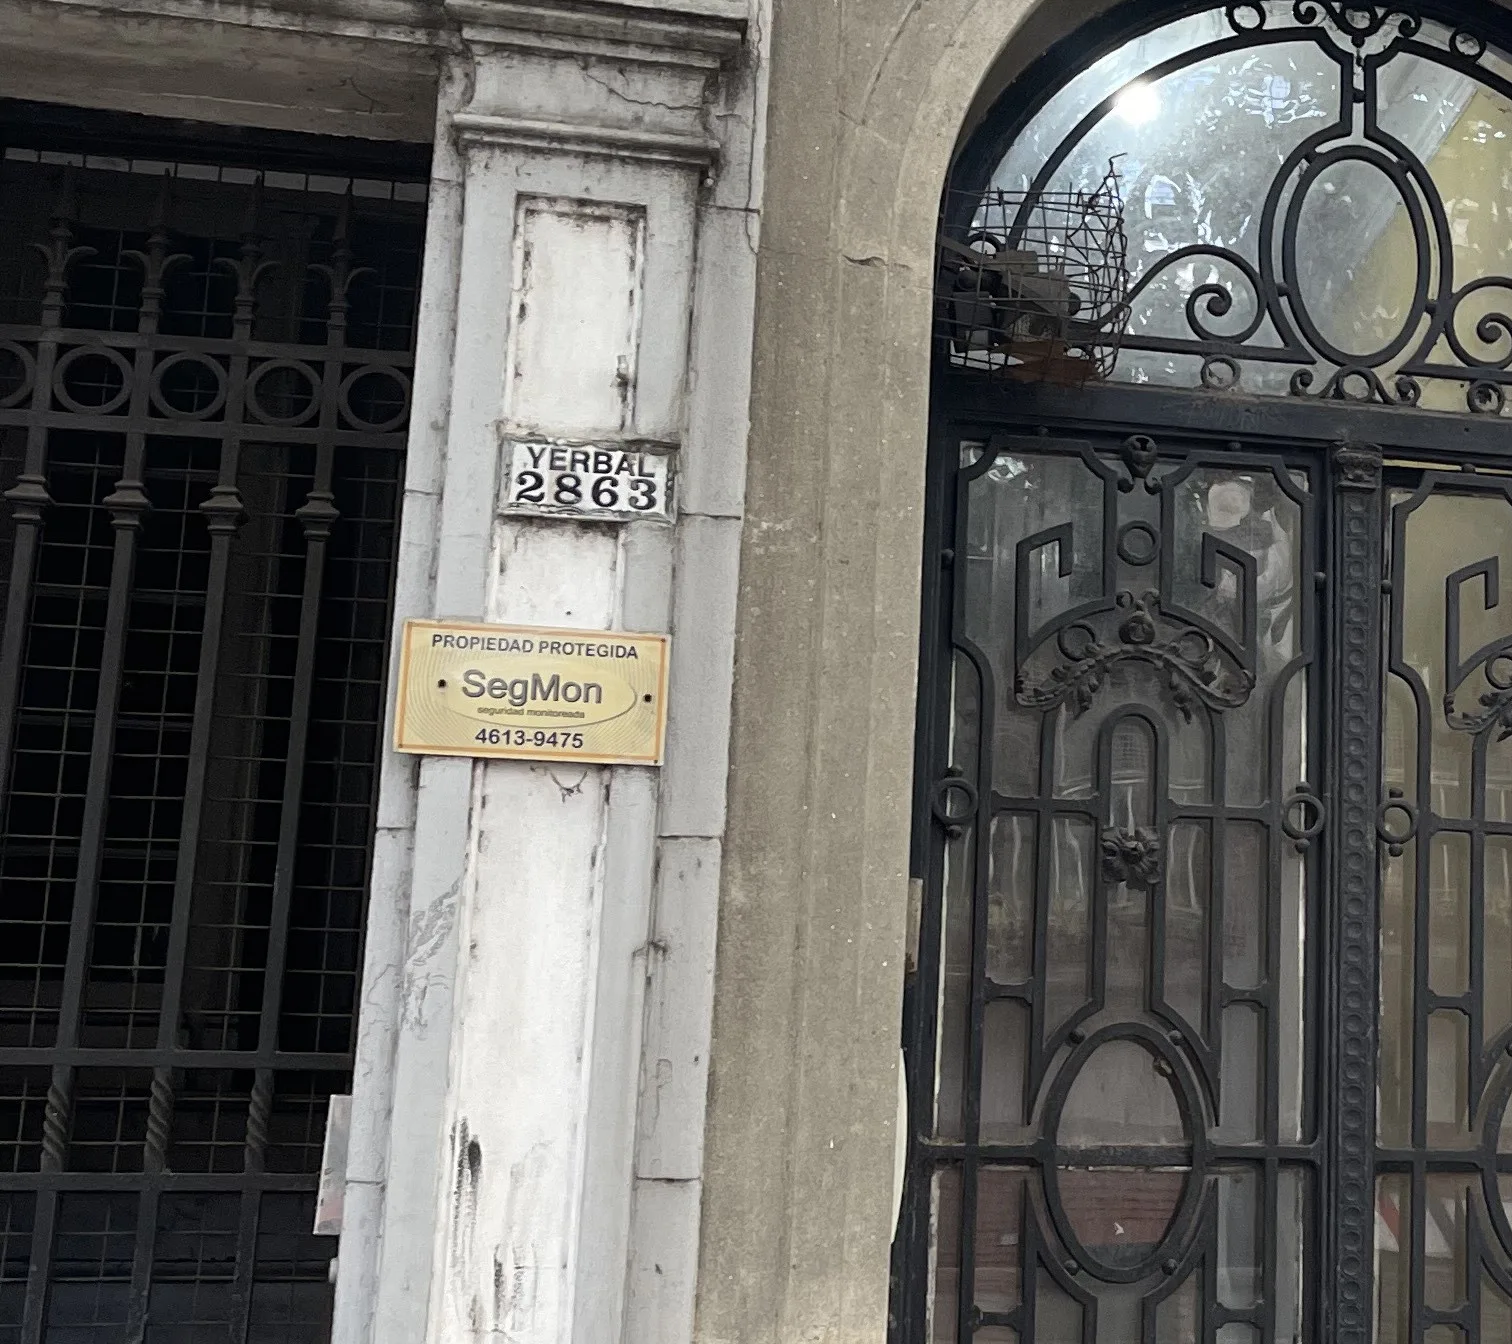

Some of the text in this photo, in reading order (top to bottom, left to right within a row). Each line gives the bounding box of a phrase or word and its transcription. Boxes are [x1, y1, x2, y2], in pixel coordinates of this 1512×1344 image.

[527, 446, 656, 478] YERBAL
[515, 470, 658, 511] 2863
[431, 633, 639, 660] PROPIEDAD PROTEGIDA
[461, 668, 603, 707] SegMon
[477, 706, 525, 716] seguridad
[474, 728, 584, 749] 4613-9475
